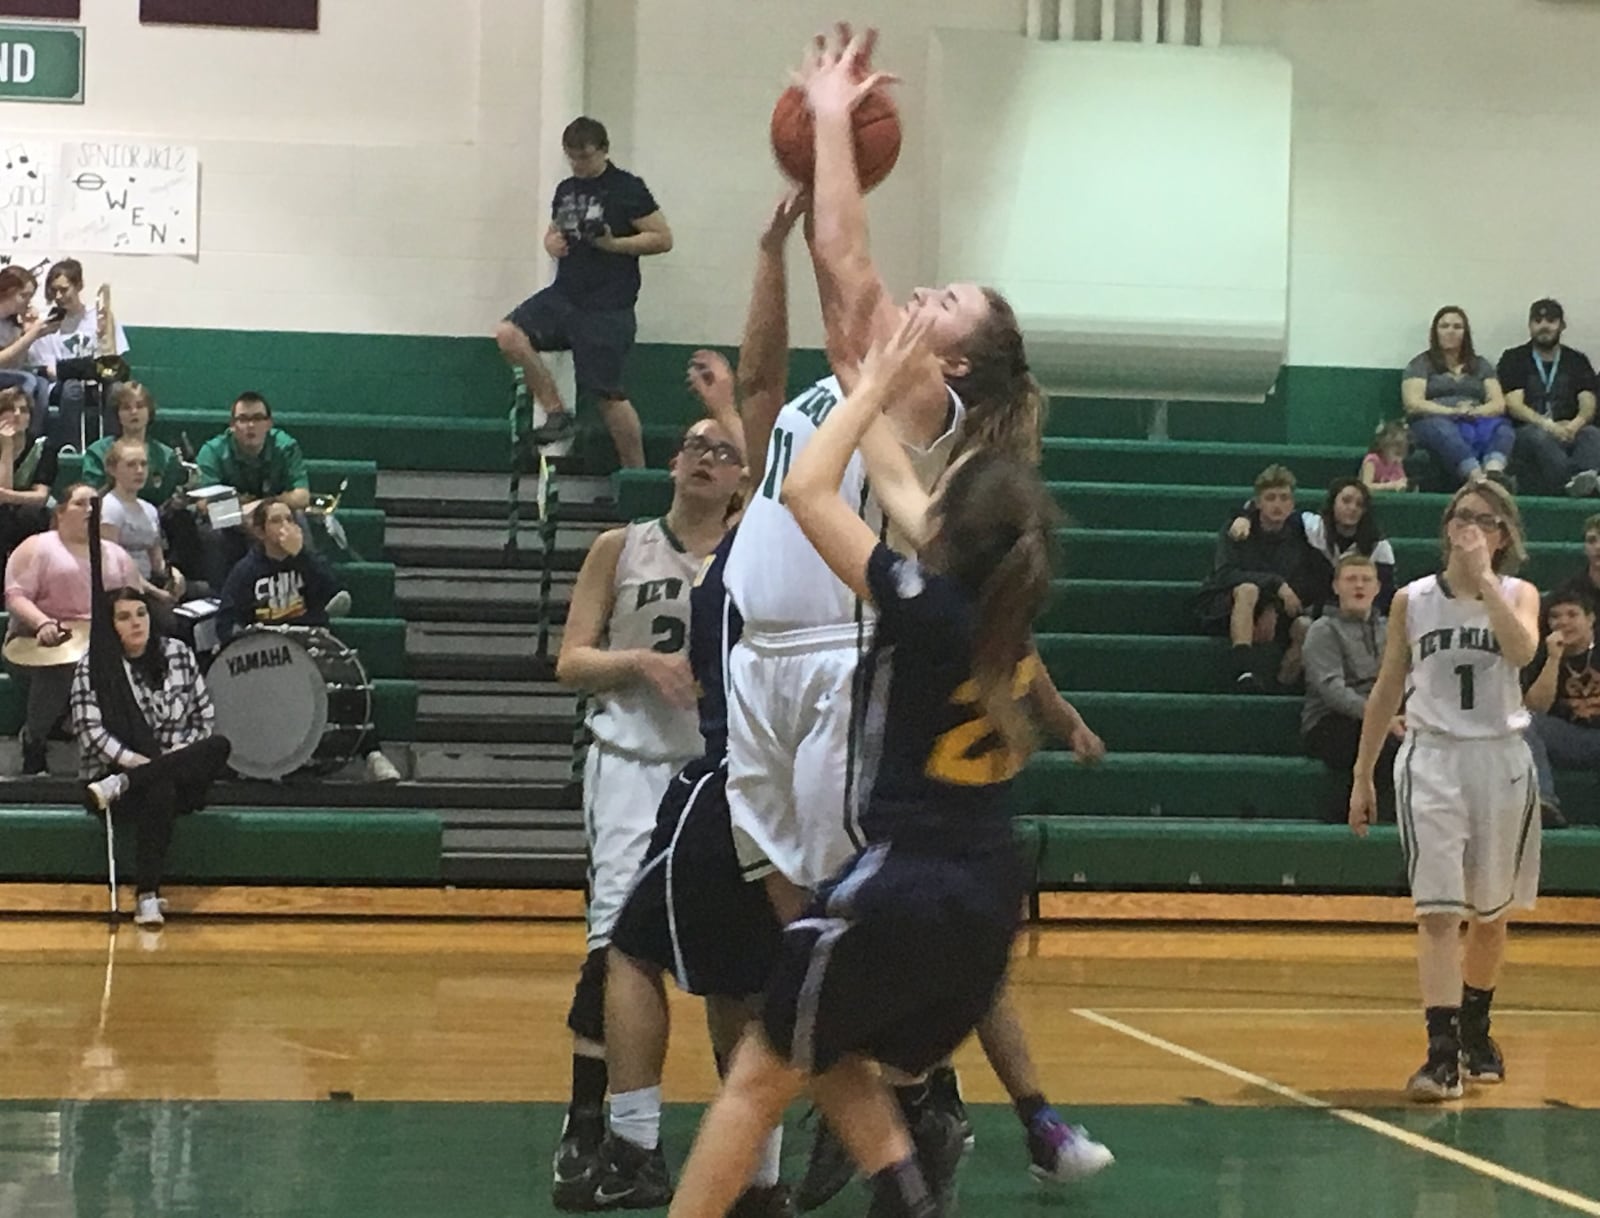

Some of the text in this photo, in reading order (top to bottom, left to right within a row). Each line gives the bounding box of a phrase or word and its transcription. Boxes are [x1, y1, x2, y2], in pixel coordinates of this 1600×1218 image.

[1418, 628, 1455, 661] NEW
[225, 645, 293, 678] YAMAHA
[1454, 663, 1475, 711] 1
